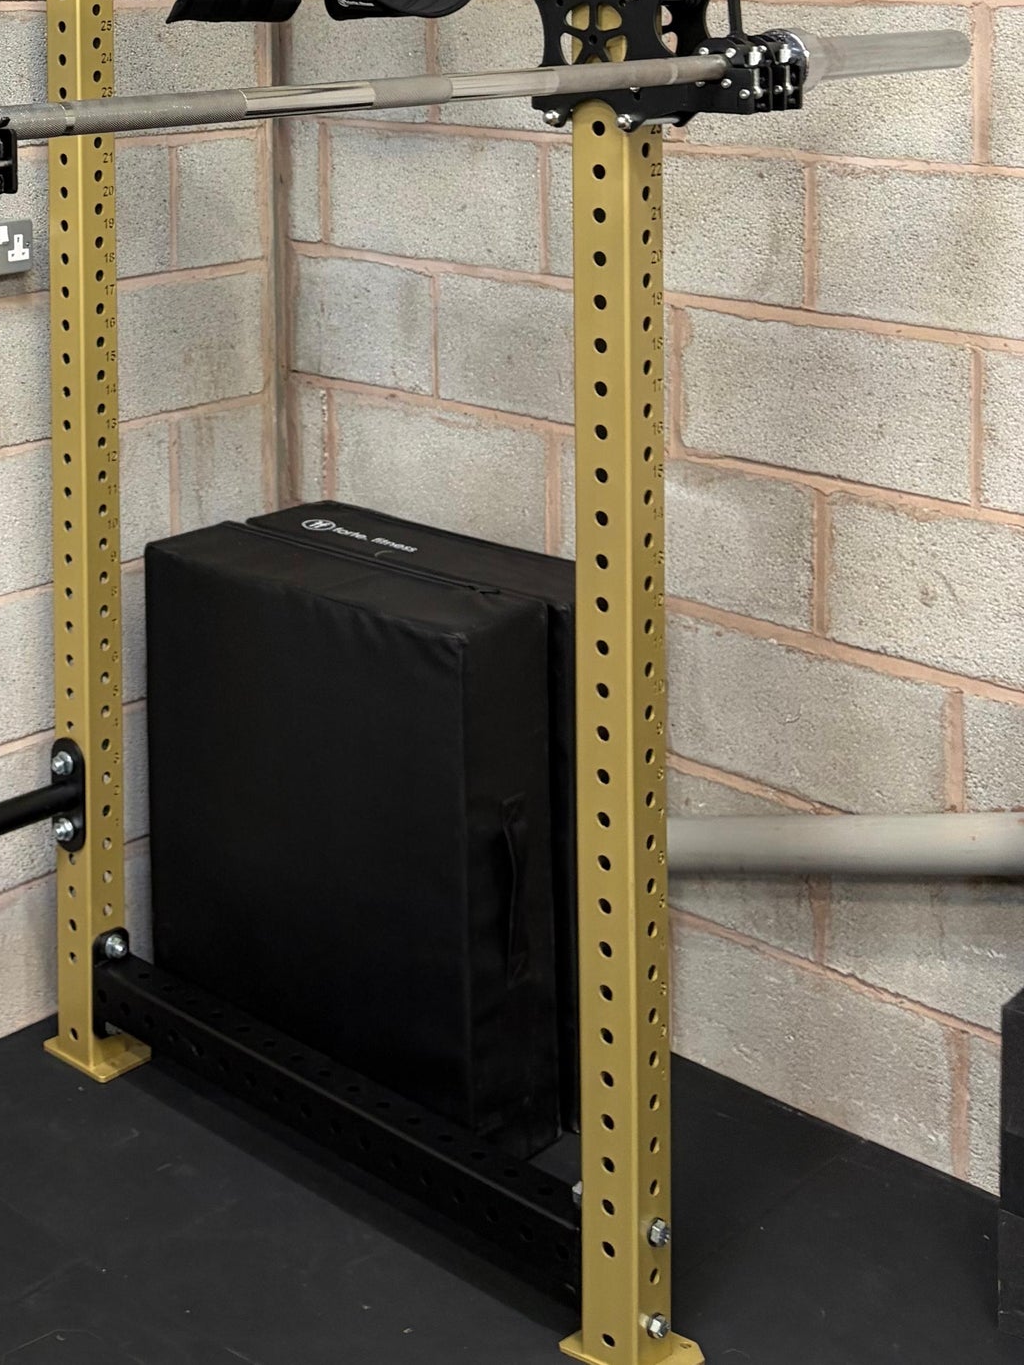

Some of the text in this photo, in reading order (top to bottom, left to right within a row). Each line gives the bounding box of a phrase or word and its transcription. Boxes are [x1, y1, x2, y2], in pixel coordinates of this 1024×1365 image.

[100, 20, 112, 32] 25
[101, 53, 112, 64] 24
[102, 88, 112, 98] 23
[103, 153, 113, 164] 21
[650, 162, 662, 177] 22
[103, 186, 114, 196] 20
[104, 218, 114, 228] 19
[104, 284, 115, 296] 17
[105, 318, 116, 328] 16
[105, 350, 116, 362] 15
